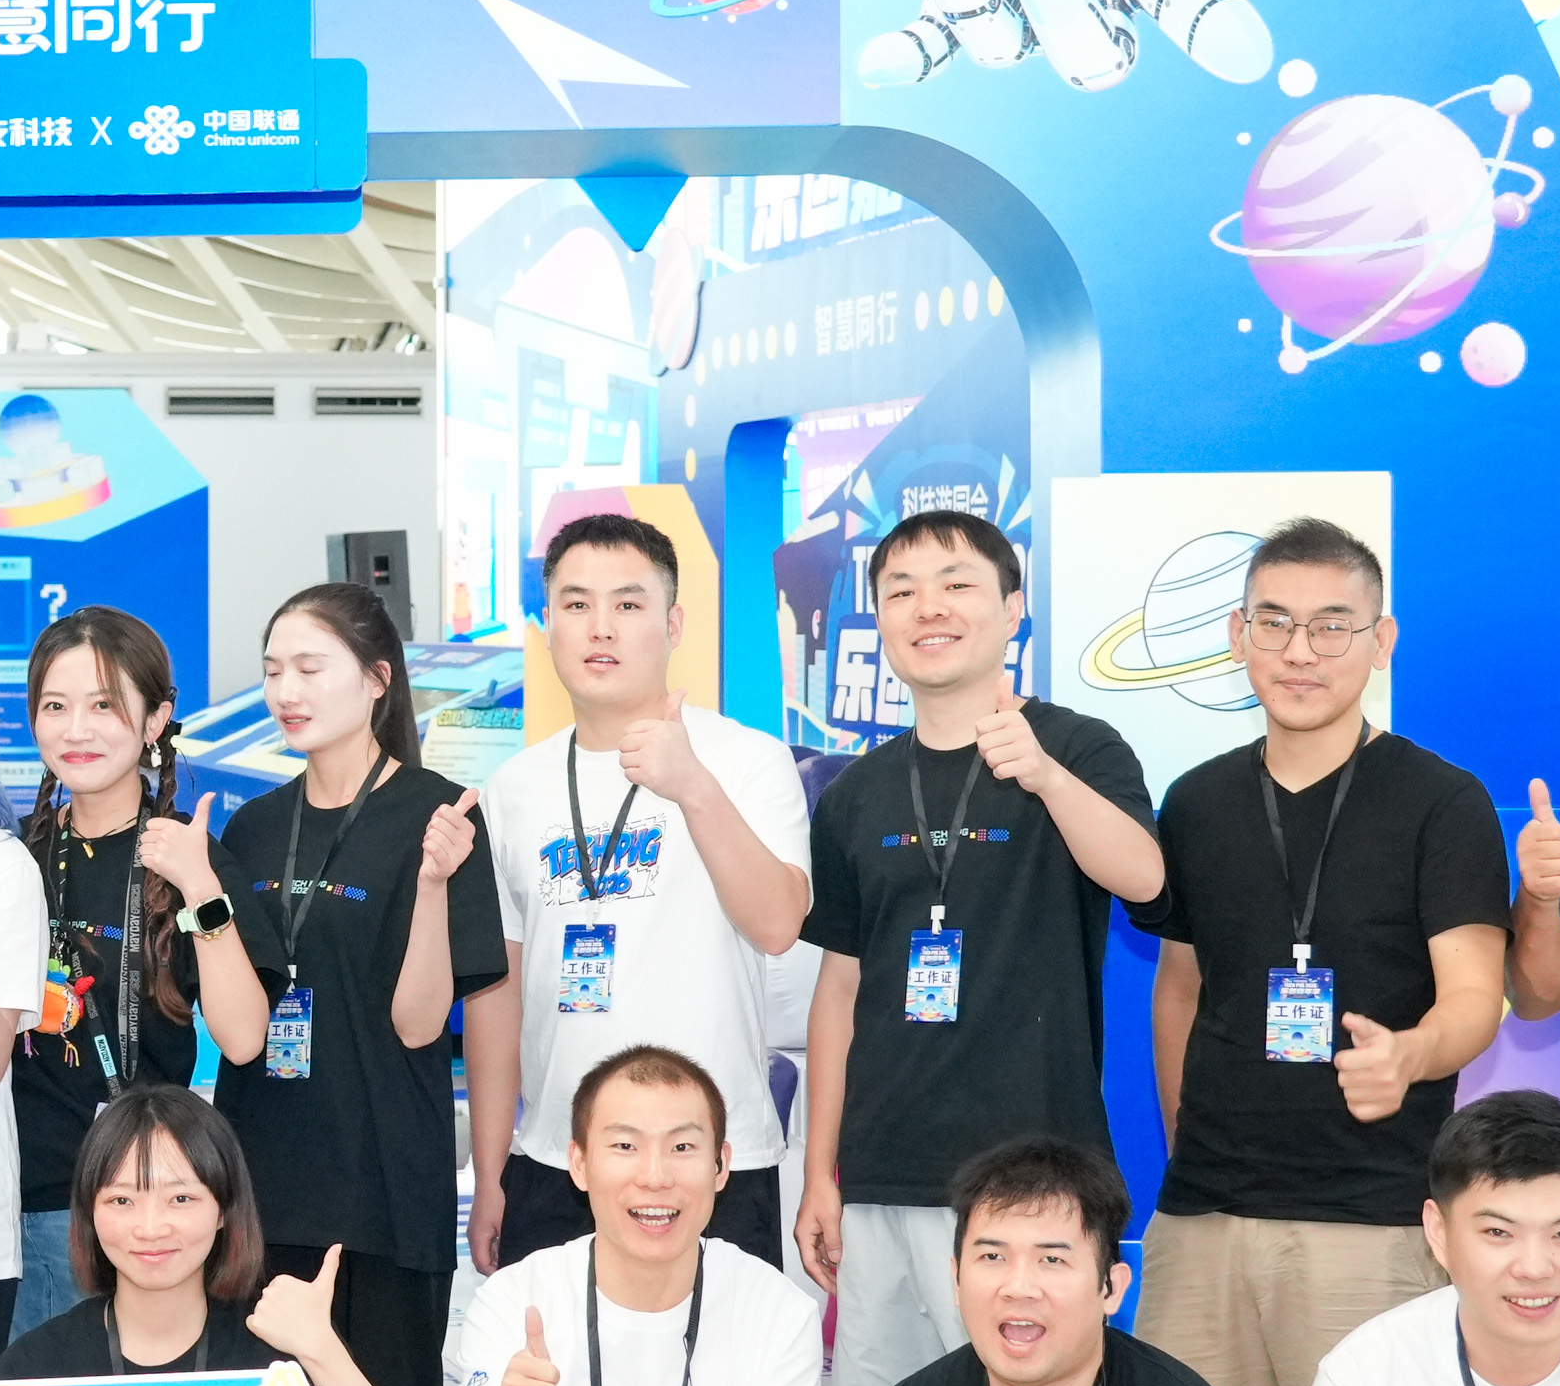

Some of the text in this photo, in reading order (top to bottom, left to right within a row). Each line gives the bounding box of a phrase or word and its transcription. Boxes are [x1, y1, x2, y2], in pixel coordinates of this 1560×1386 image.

[204, 109, 301, 132] 中国联通
[204, 133, 300, 147] China unicom
[814, 290, 898, 358] 智慧同行
[566, 961, 608, 976] 工作证
[913, 970, 953, 986] 工作证
[1274, 1004, 1324, 1020] 工作证
[269, 1023, 304, 1038] 工作证
